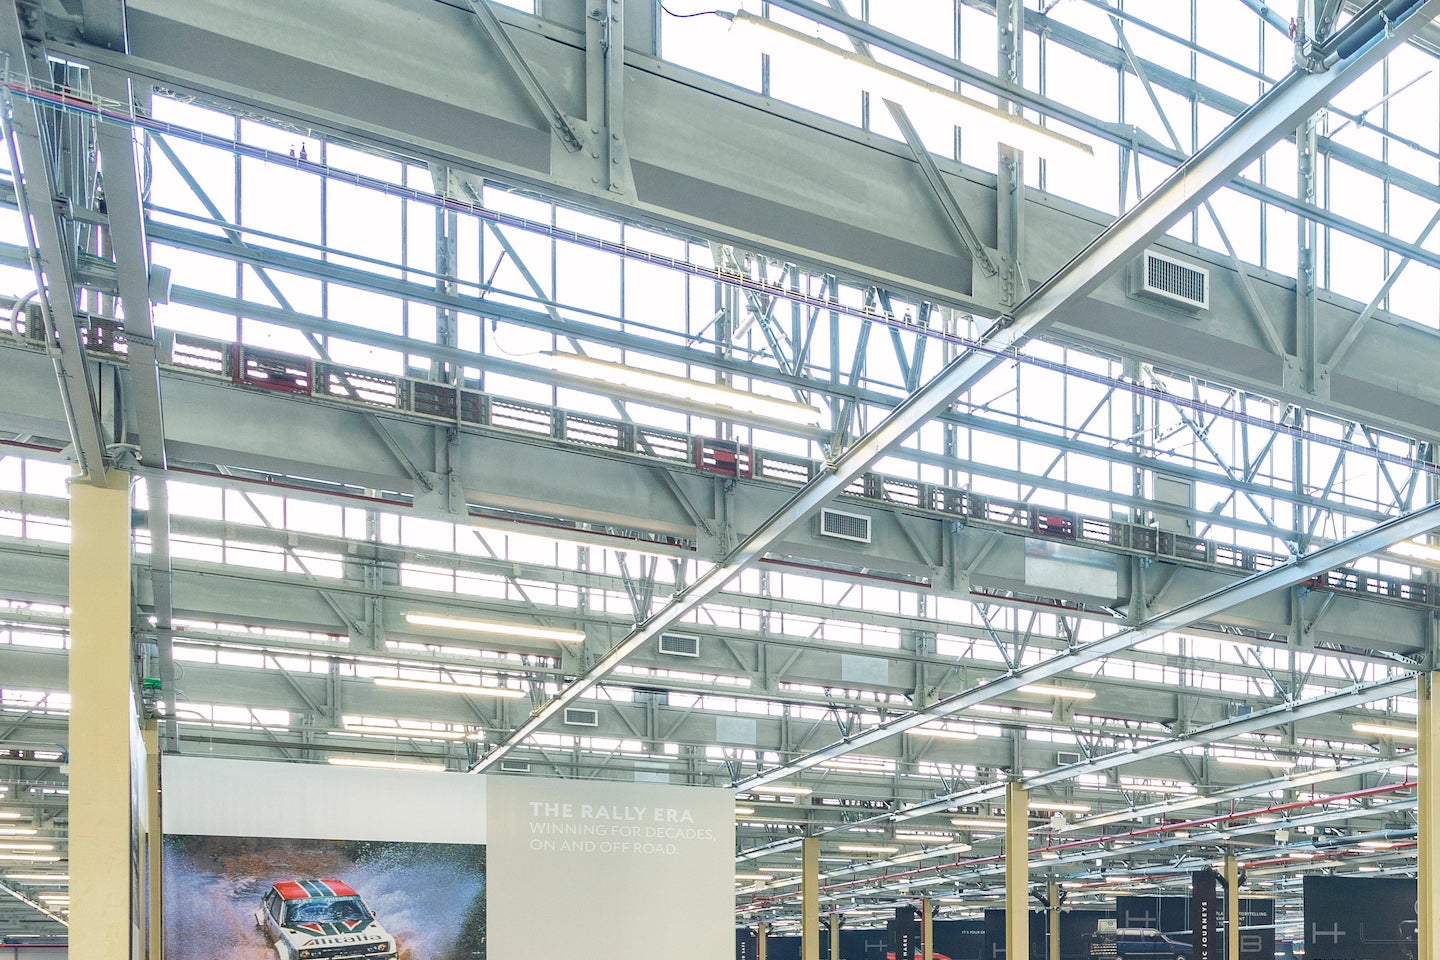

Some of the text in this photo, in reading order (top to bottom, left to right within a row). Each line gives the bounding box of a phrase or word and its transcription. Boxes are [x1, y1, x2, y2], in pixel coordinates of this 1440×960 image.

[529, 801, 694, 823] THE RALLY ERA
[529, 822, 717, 842] WINNING FOR DECADES,
[529, 839, 680, 855] ON AND OFF ROAD.
[303, 934, 382, 946] Alitalia
